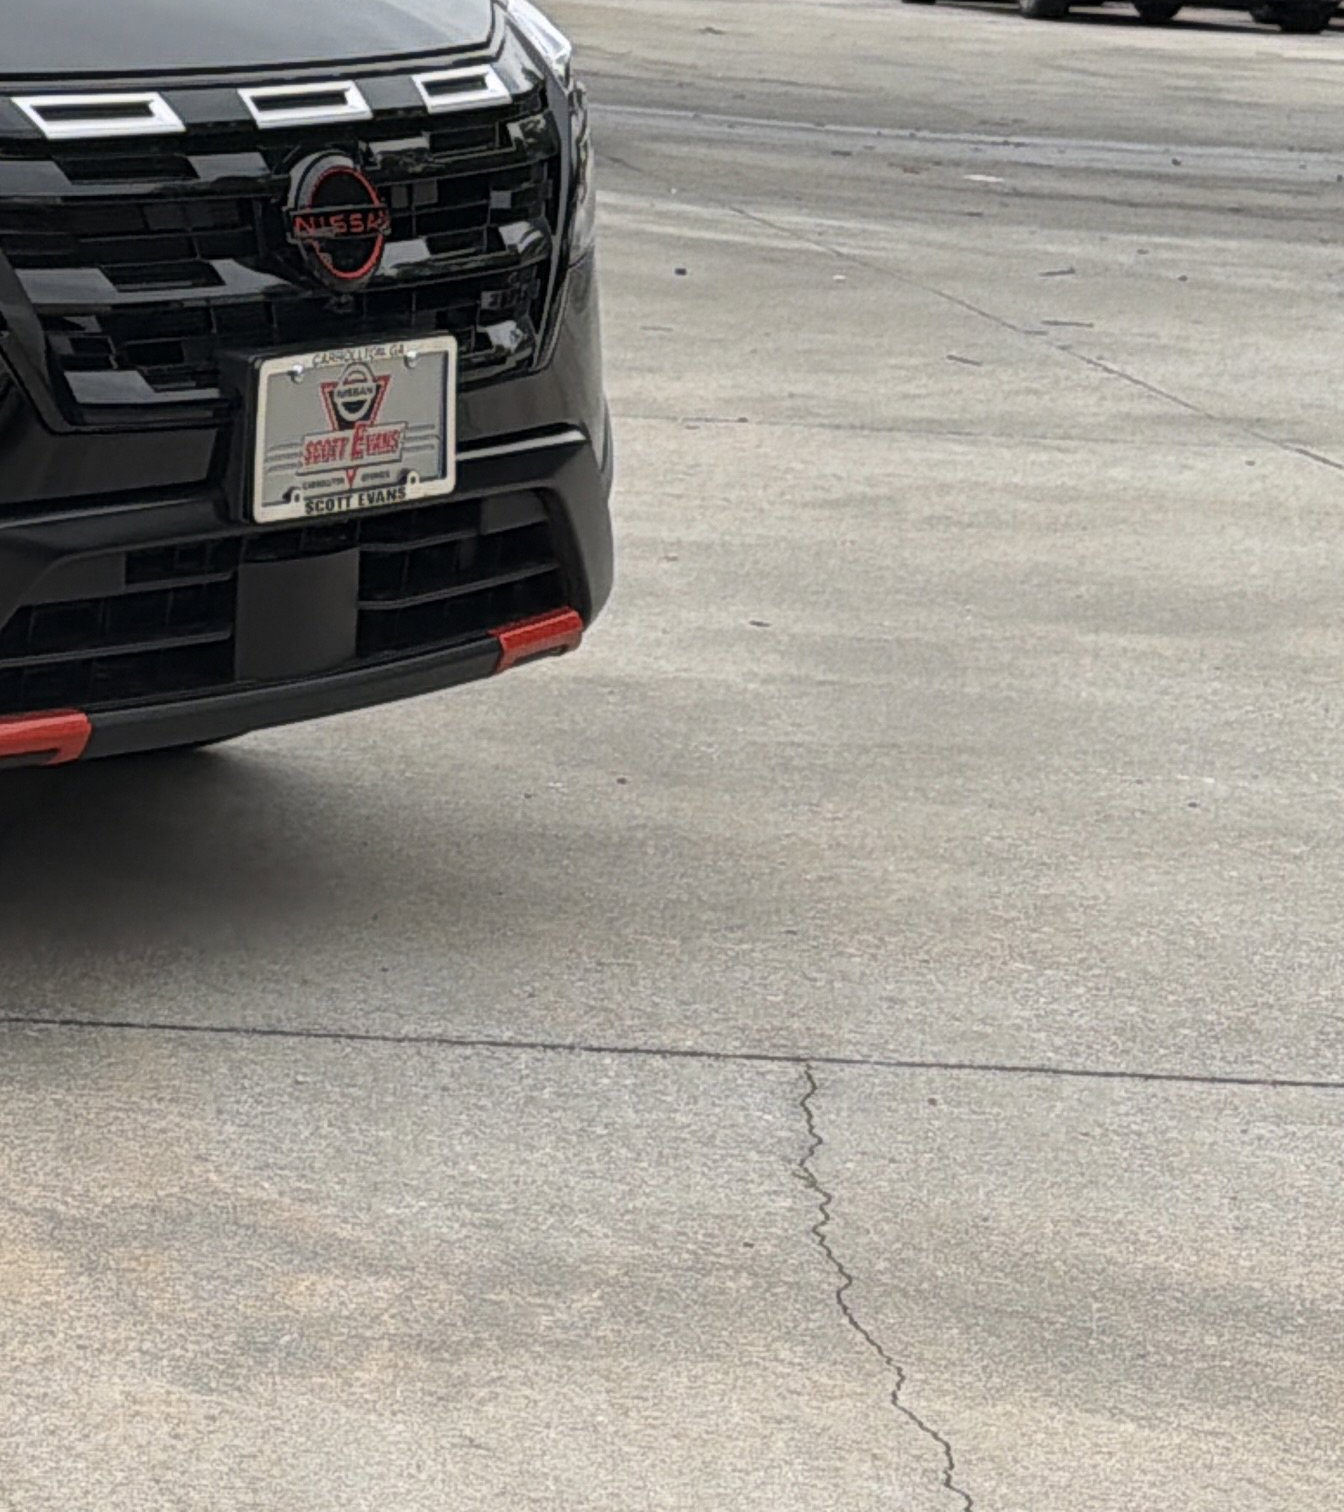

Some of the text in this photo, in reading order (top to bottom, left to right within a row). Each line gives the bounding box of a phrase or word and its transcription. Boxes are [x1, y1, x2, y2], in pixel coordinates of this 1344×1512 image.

[304, 422, 401, 466] SCOTT EVANS
[304, 486, 407, 516] SCOTT EVANS
